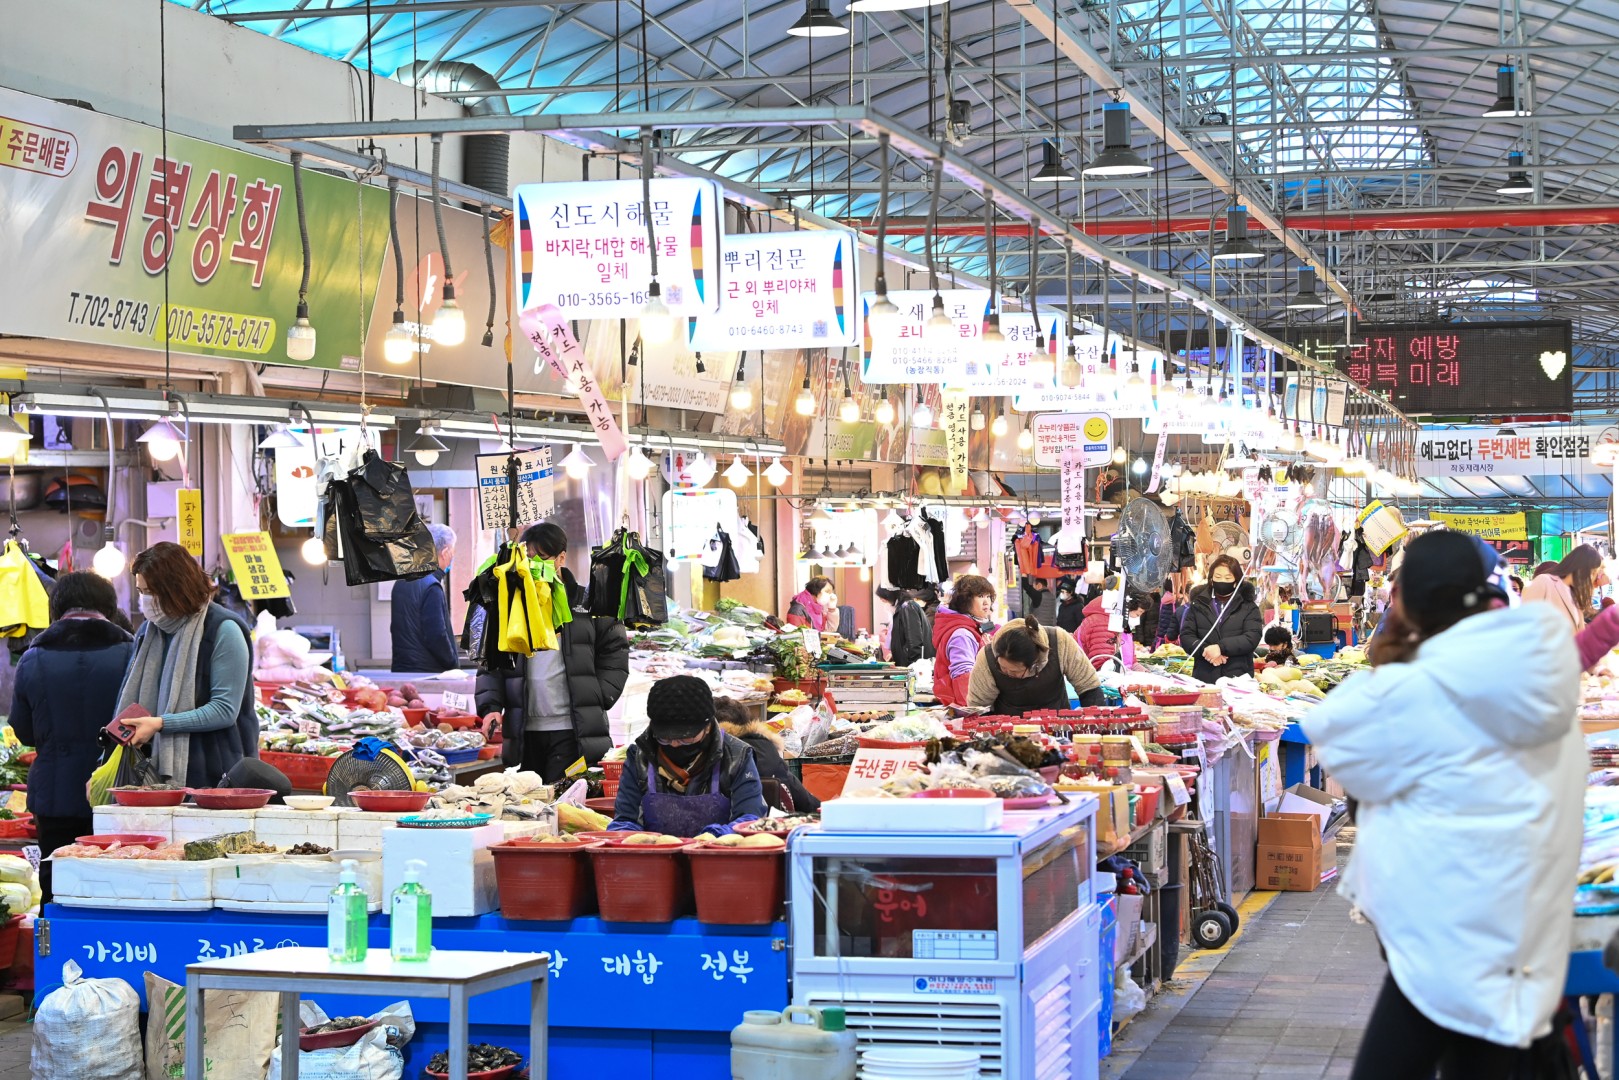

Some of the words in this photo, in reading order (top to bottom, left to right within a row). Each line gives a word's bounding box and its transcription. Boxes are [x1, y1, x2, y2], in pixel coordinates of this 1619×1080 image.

[7, 129, 69, 170] 주문배달
[85, 146, 282, 287] 의령상회
[550, 201, 673, 229] 신도시해물
[546, 237, 625, 259] 바지락,대합
[724, 248, 806, 273] 뿌리전문
[597, 262, 628, 283] 일체
[727, 281, 740, 299] 근
[745, 280, 757, 296] 외
[762, 278, 817, 296] 뿌리야채
[752, 299, 779, 318] 일체
[67, 292, 149, 335] T.702-8743
[167, 308, 271, 351] 010-3578-8747
[1409, 335, 1460, 361] 예방
[552, 323, 576, 353] 카드
[572, 360, 594, 393] 사용
[589, 399, 610, 431] 가능
[1348, 363, 1399, 388] 행복
[1410, 361, 1460, 387] 미래
[957, 403, 966, 421] 카드
[956, 427, 966, 447] 사용
[1421, 438, 1473, 462] 예고없다
[1477, 437, 1531, 461] 두번세번
[1535, 434, 1590, 459] 확인점검
[956, 453, 966, 474] 가능
[1074, 461, 1083, 479] 카드
[184, 502, 196, 537] 파슬리
[1074, 505, 1083, 525] 가능
[248, 564, 266, 574] 생강
[251, 574, 269, 584] 양파
[83, 940, 158, 964] 가리비
[601, 949, 663, 984] 대합
[701, 949, 754, 984] 전복
